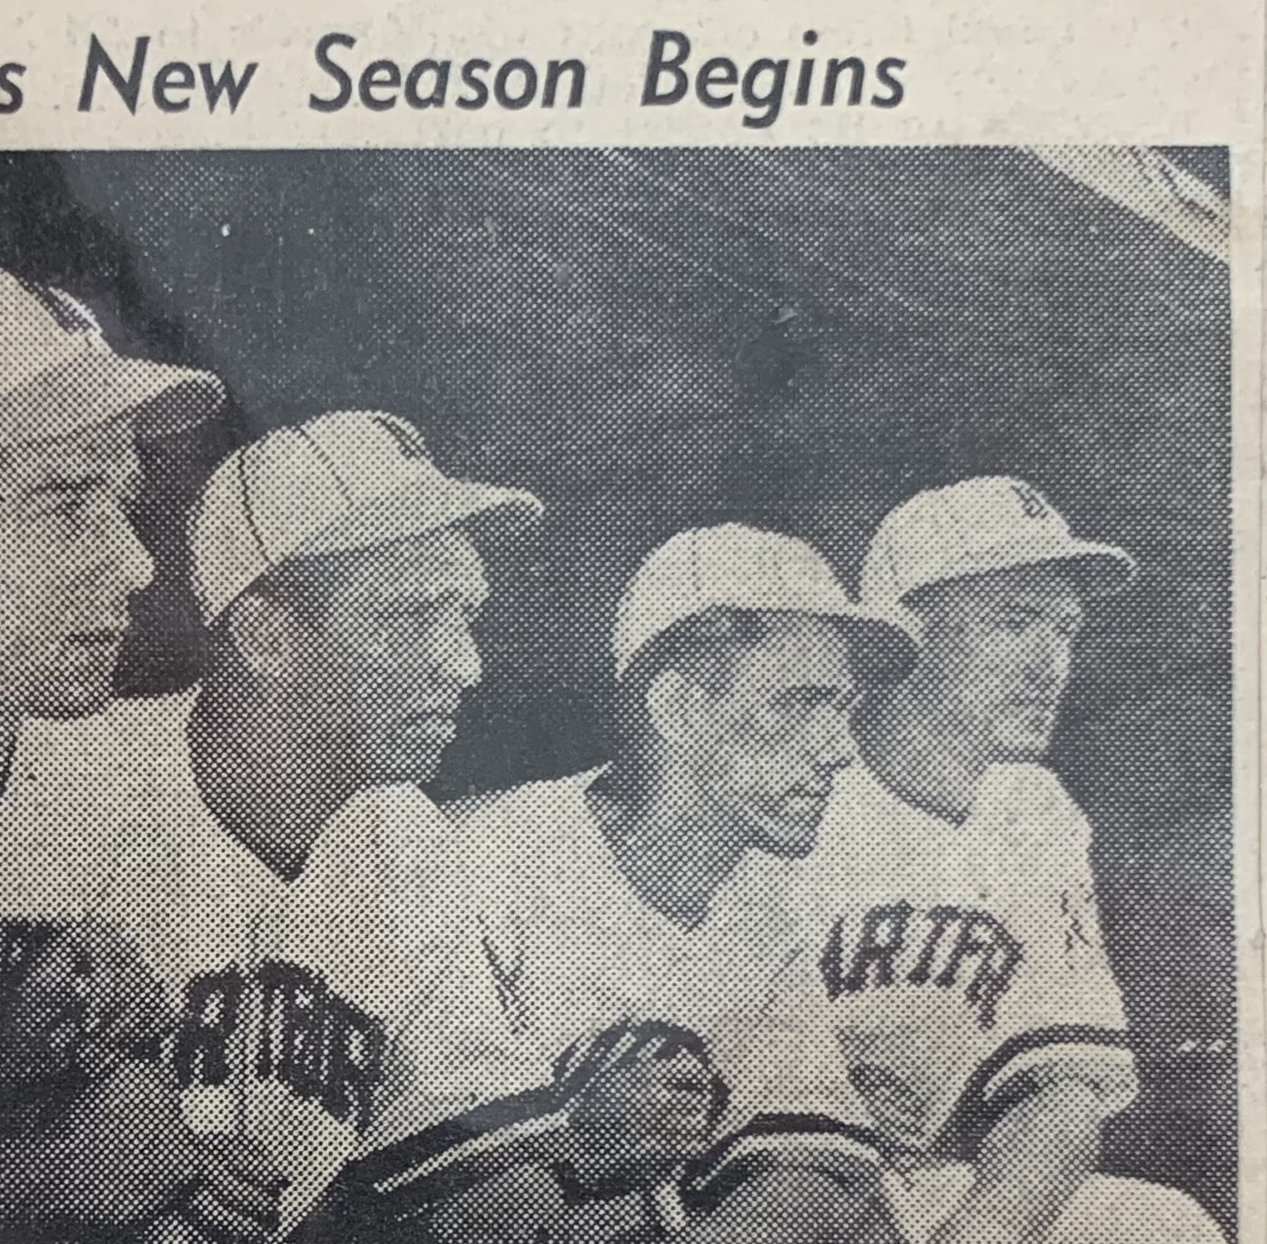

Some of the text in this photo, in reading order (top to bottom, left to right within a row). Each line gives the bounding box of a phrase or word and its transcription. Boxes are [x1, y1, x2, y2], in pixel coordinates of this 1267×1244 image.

[77, 33, 259, 116] New
[308, 32, 586, 113] Season
[641, 29, 906, 129] Begins
